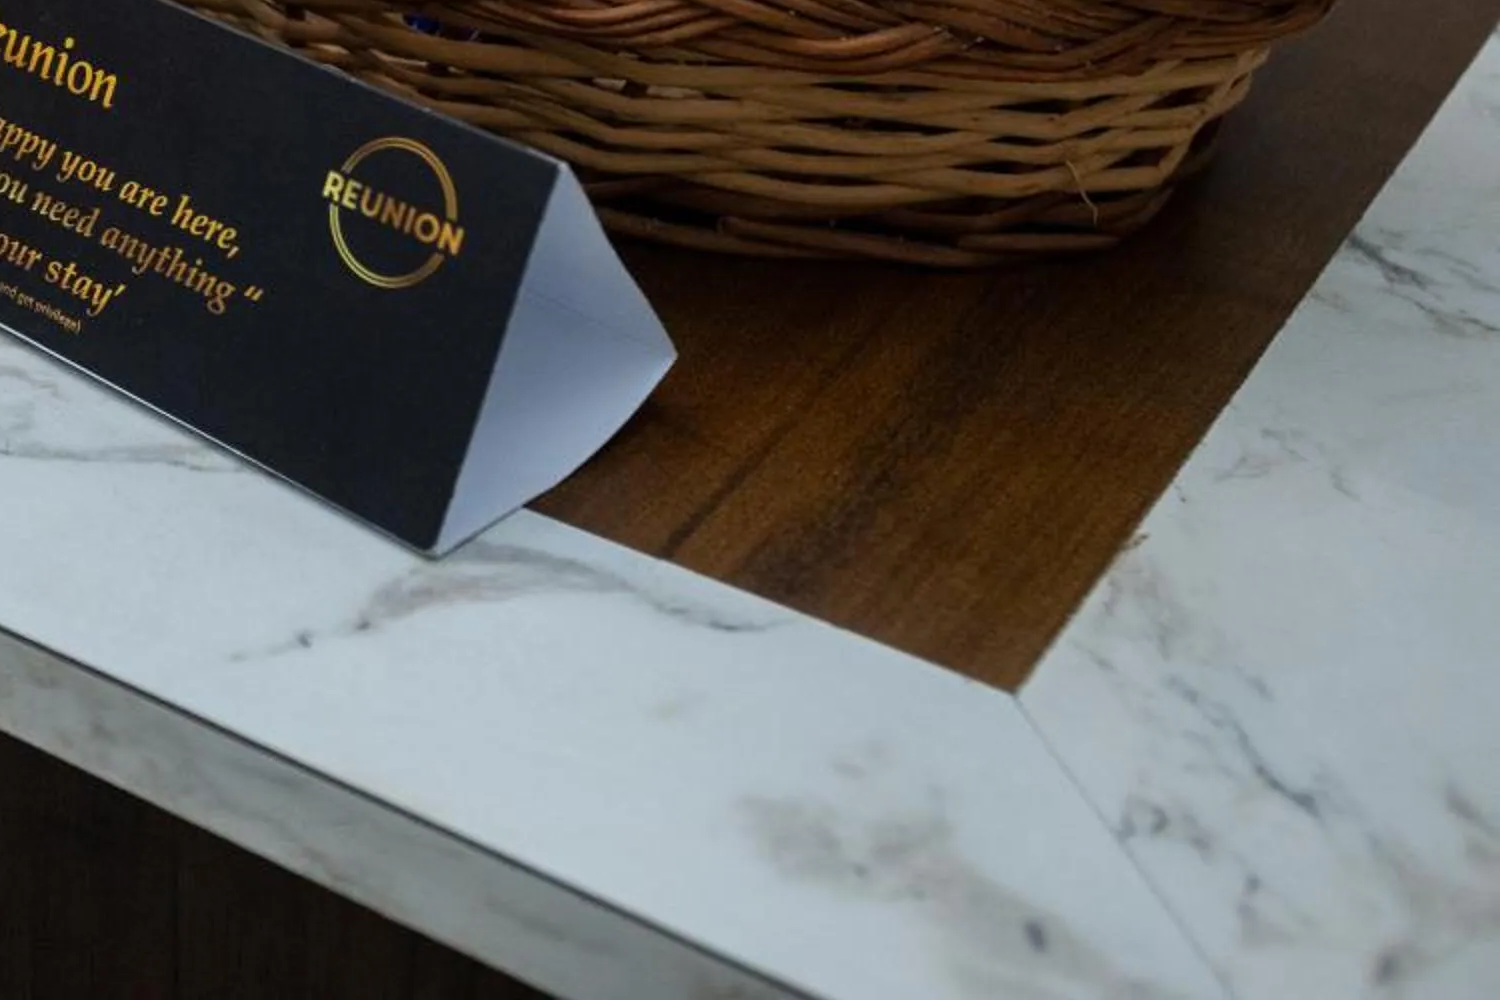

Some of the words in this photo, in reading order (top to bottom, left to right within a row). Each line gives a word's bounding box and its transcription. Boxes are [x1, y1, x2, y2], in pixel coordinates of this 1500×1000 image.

[31, 191, 100, 238] need
[100, 226, 236, 315] anything
[56, 150, 116, 192] you
[119, 180, 169, 216] are
[170, 194, 240, 259] here,
[321, 169, 465, 256] REUNION
